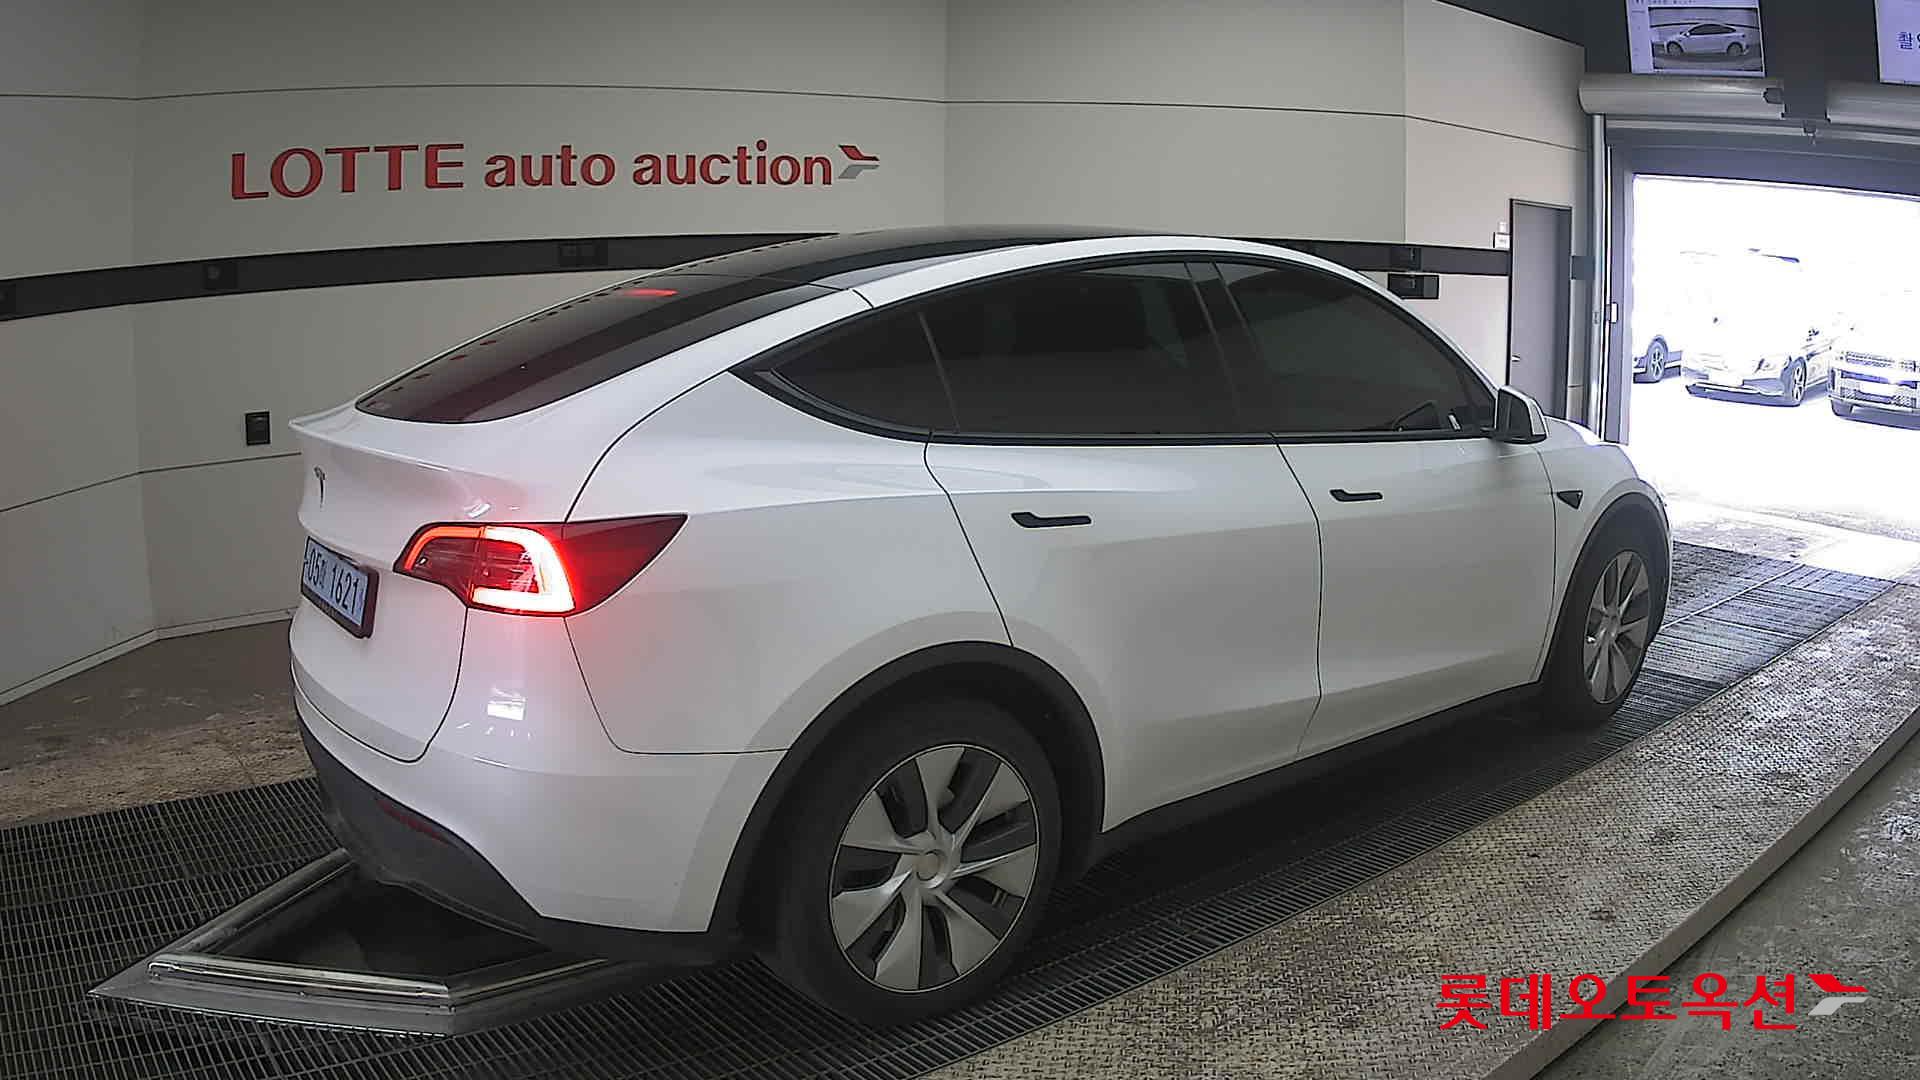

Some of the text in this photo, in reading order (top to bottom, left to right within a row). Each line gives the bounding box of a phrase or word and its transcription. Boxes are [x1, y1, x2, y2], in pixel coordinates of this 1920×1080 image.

[231, 139, 833, 199] LOTTE auto auction
[330, 564, 360, 615] 1621
